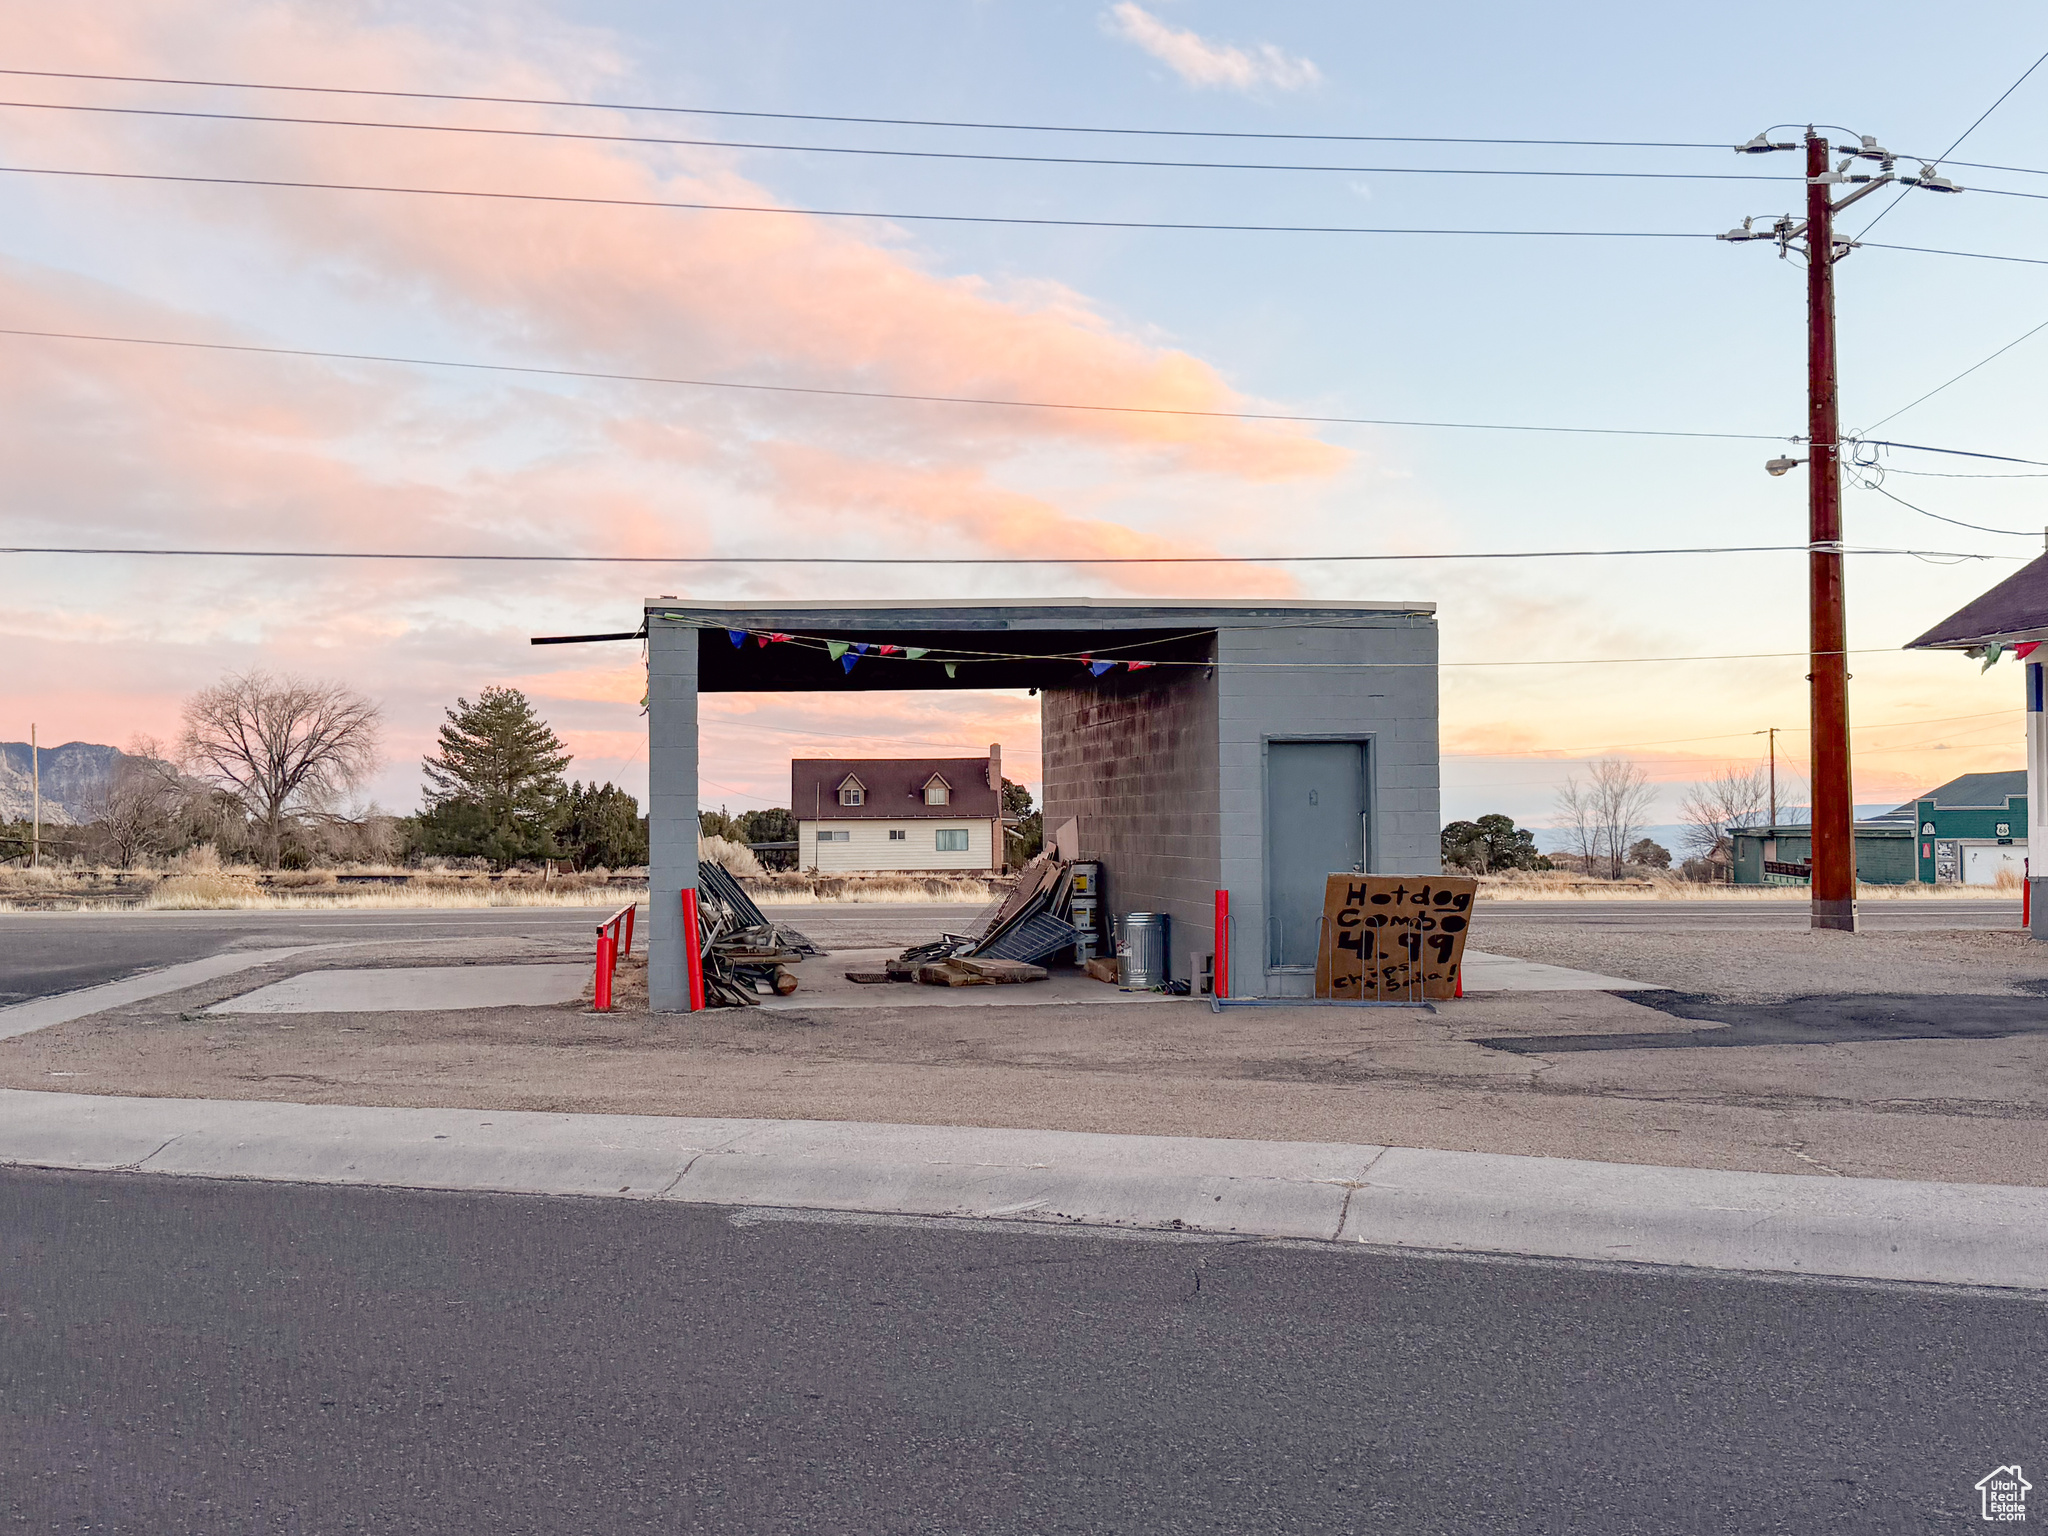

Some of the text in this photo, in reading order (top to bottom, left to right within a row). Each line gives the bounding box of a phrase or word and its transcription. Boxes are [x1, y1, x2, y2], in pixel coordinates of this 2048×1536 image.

[1345, 883, 1471, 912] Hotdog
[1337, 908, 1467, 932] Combo
[1337, 930, 1454, 964] 4.99
